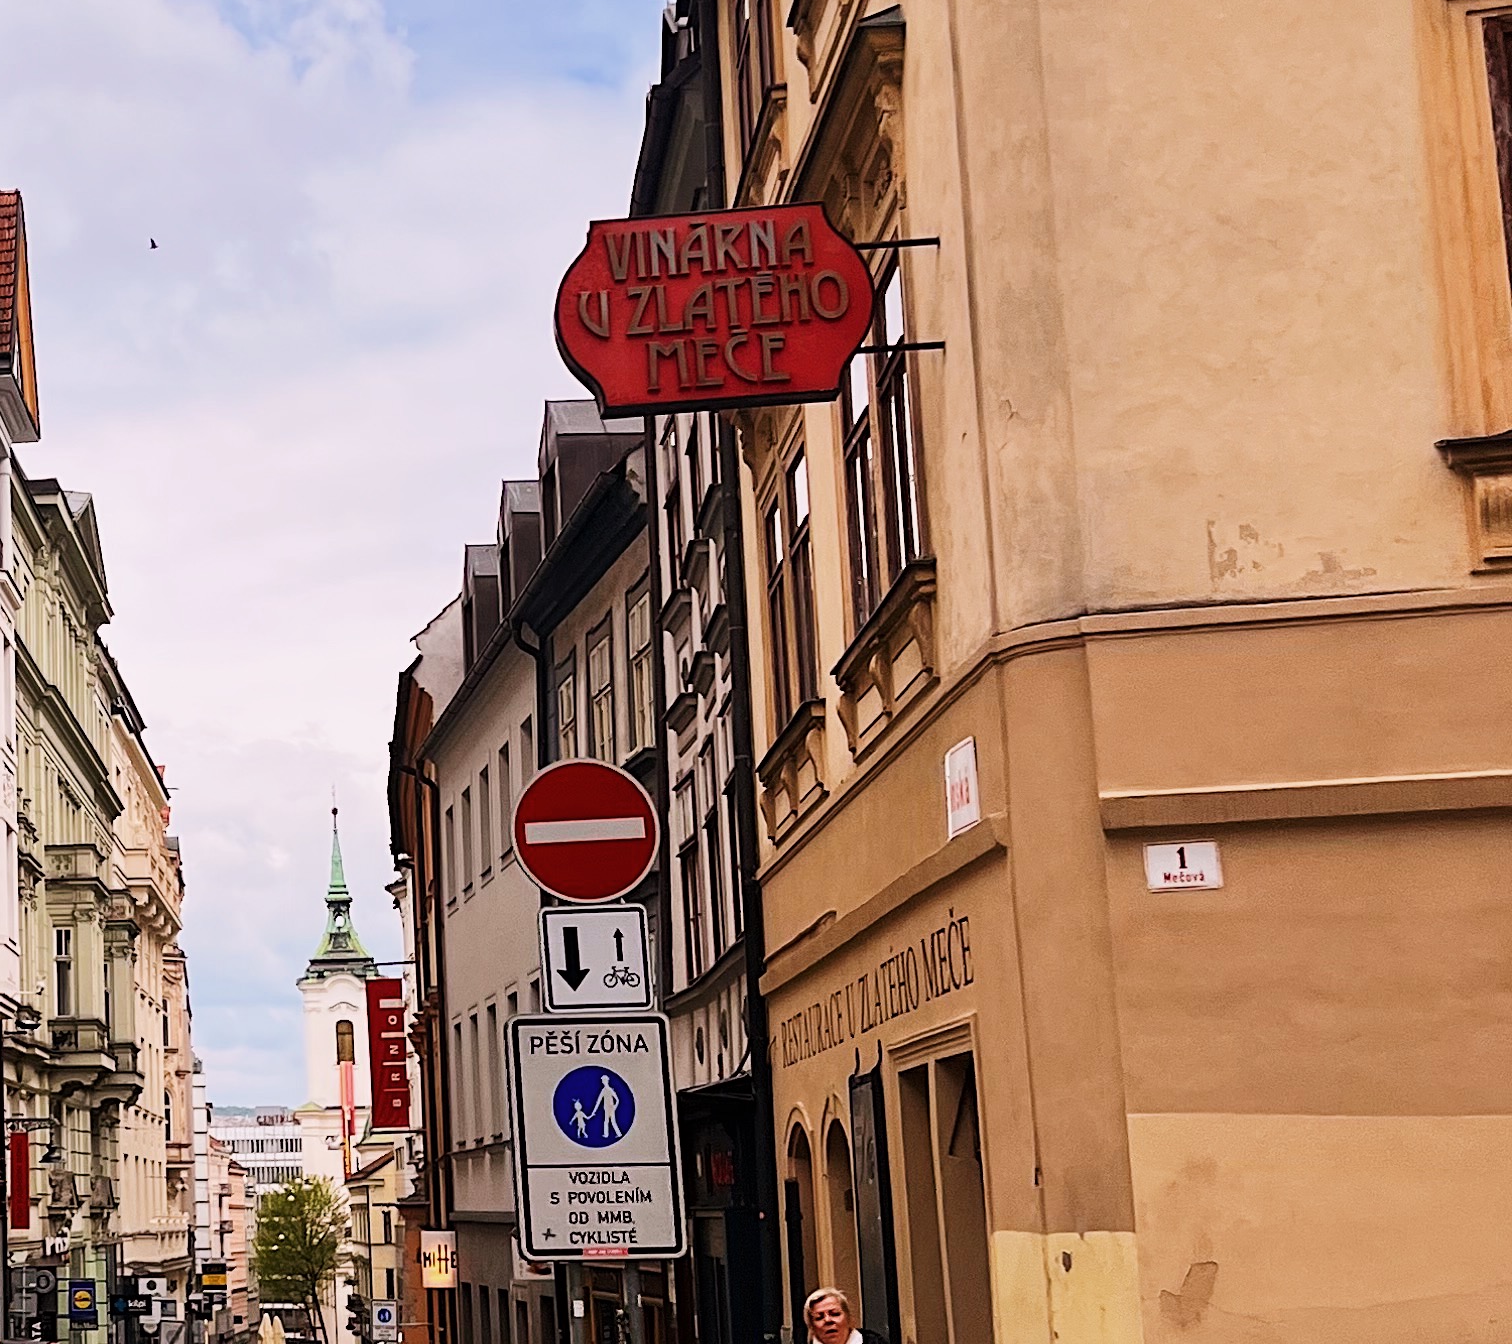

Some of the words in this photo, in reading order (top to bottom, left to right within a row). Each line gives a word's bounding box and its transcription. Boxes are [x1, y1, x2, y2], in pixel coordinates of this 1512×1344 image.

[577, 289, 611, 339] U
[1176, 846, 1188, 869] 1
[781, 990, 844, 1068] RESTAURACE
[845, 982, 856, 1039] U
[858, 946, 920, 1035] ZLATÉHO
[919, 906, 975, 1002] MEČE
[529, 1030, 581, 1055] PĚŠÍ
[587, 1030, 649, 1054] ZÓNA
[568, 1171, 631, 1185] VOZIDLA
[550, 1191, 560, 1205] S
[568, 1187, 652, 1205] POVOLENÍM
[568, 1211, 590, 1225] OD
[569, 1227, 638, 1245] CYKLISTÉ
